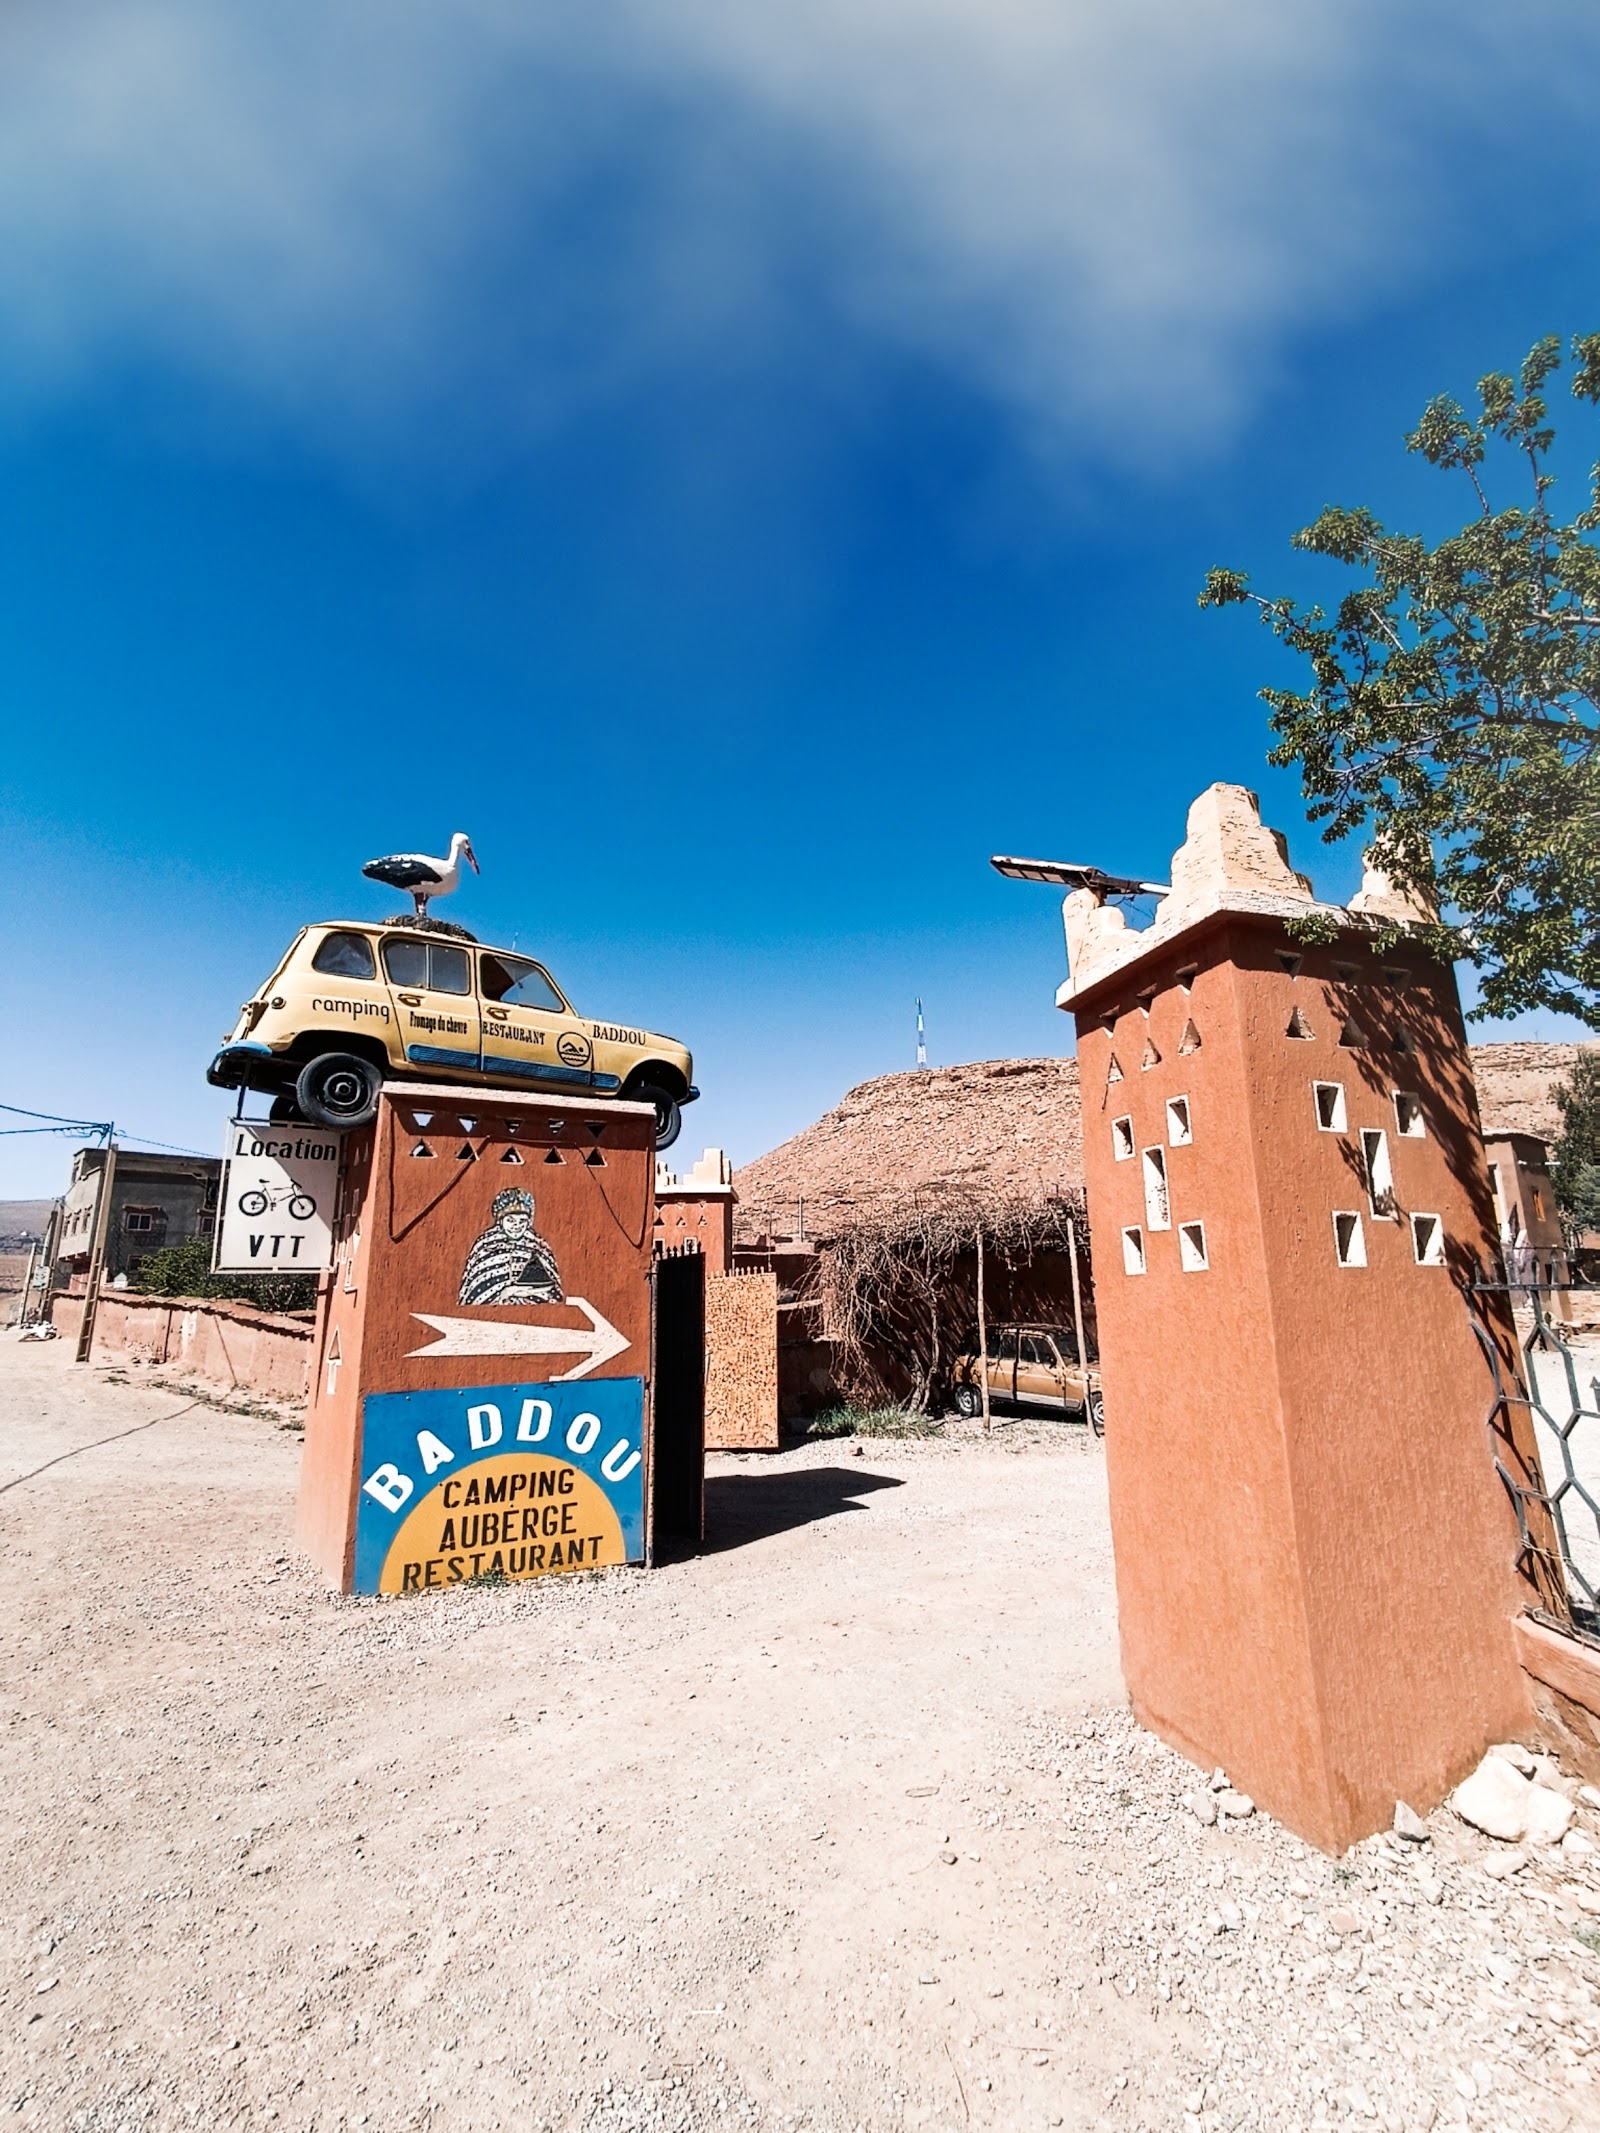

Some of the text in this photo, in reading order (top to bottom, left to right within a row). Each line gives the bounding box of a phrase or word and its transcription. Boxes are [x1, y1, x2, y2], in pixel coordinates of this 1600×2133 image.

[312, 999, 390, 1024] camping
[410, 1010, 436, 1034] Fromage
[437, 1014, 446, 1031] du
[481, 1020, 546, 1046] RESTAURANT
[592, 1024, 647, 1046] BADDOU
[235, 1134, 337, 1161] Location
[249, 1234, 305, 1258] VTT
[362, 1398, 642, 1514] BADDOU
[443, 1468, 575, 1509] CAMPING
[438, 1502, 579, 1553] AUBERGE
[402, 1535, 604, 1592] RESTAURANT
